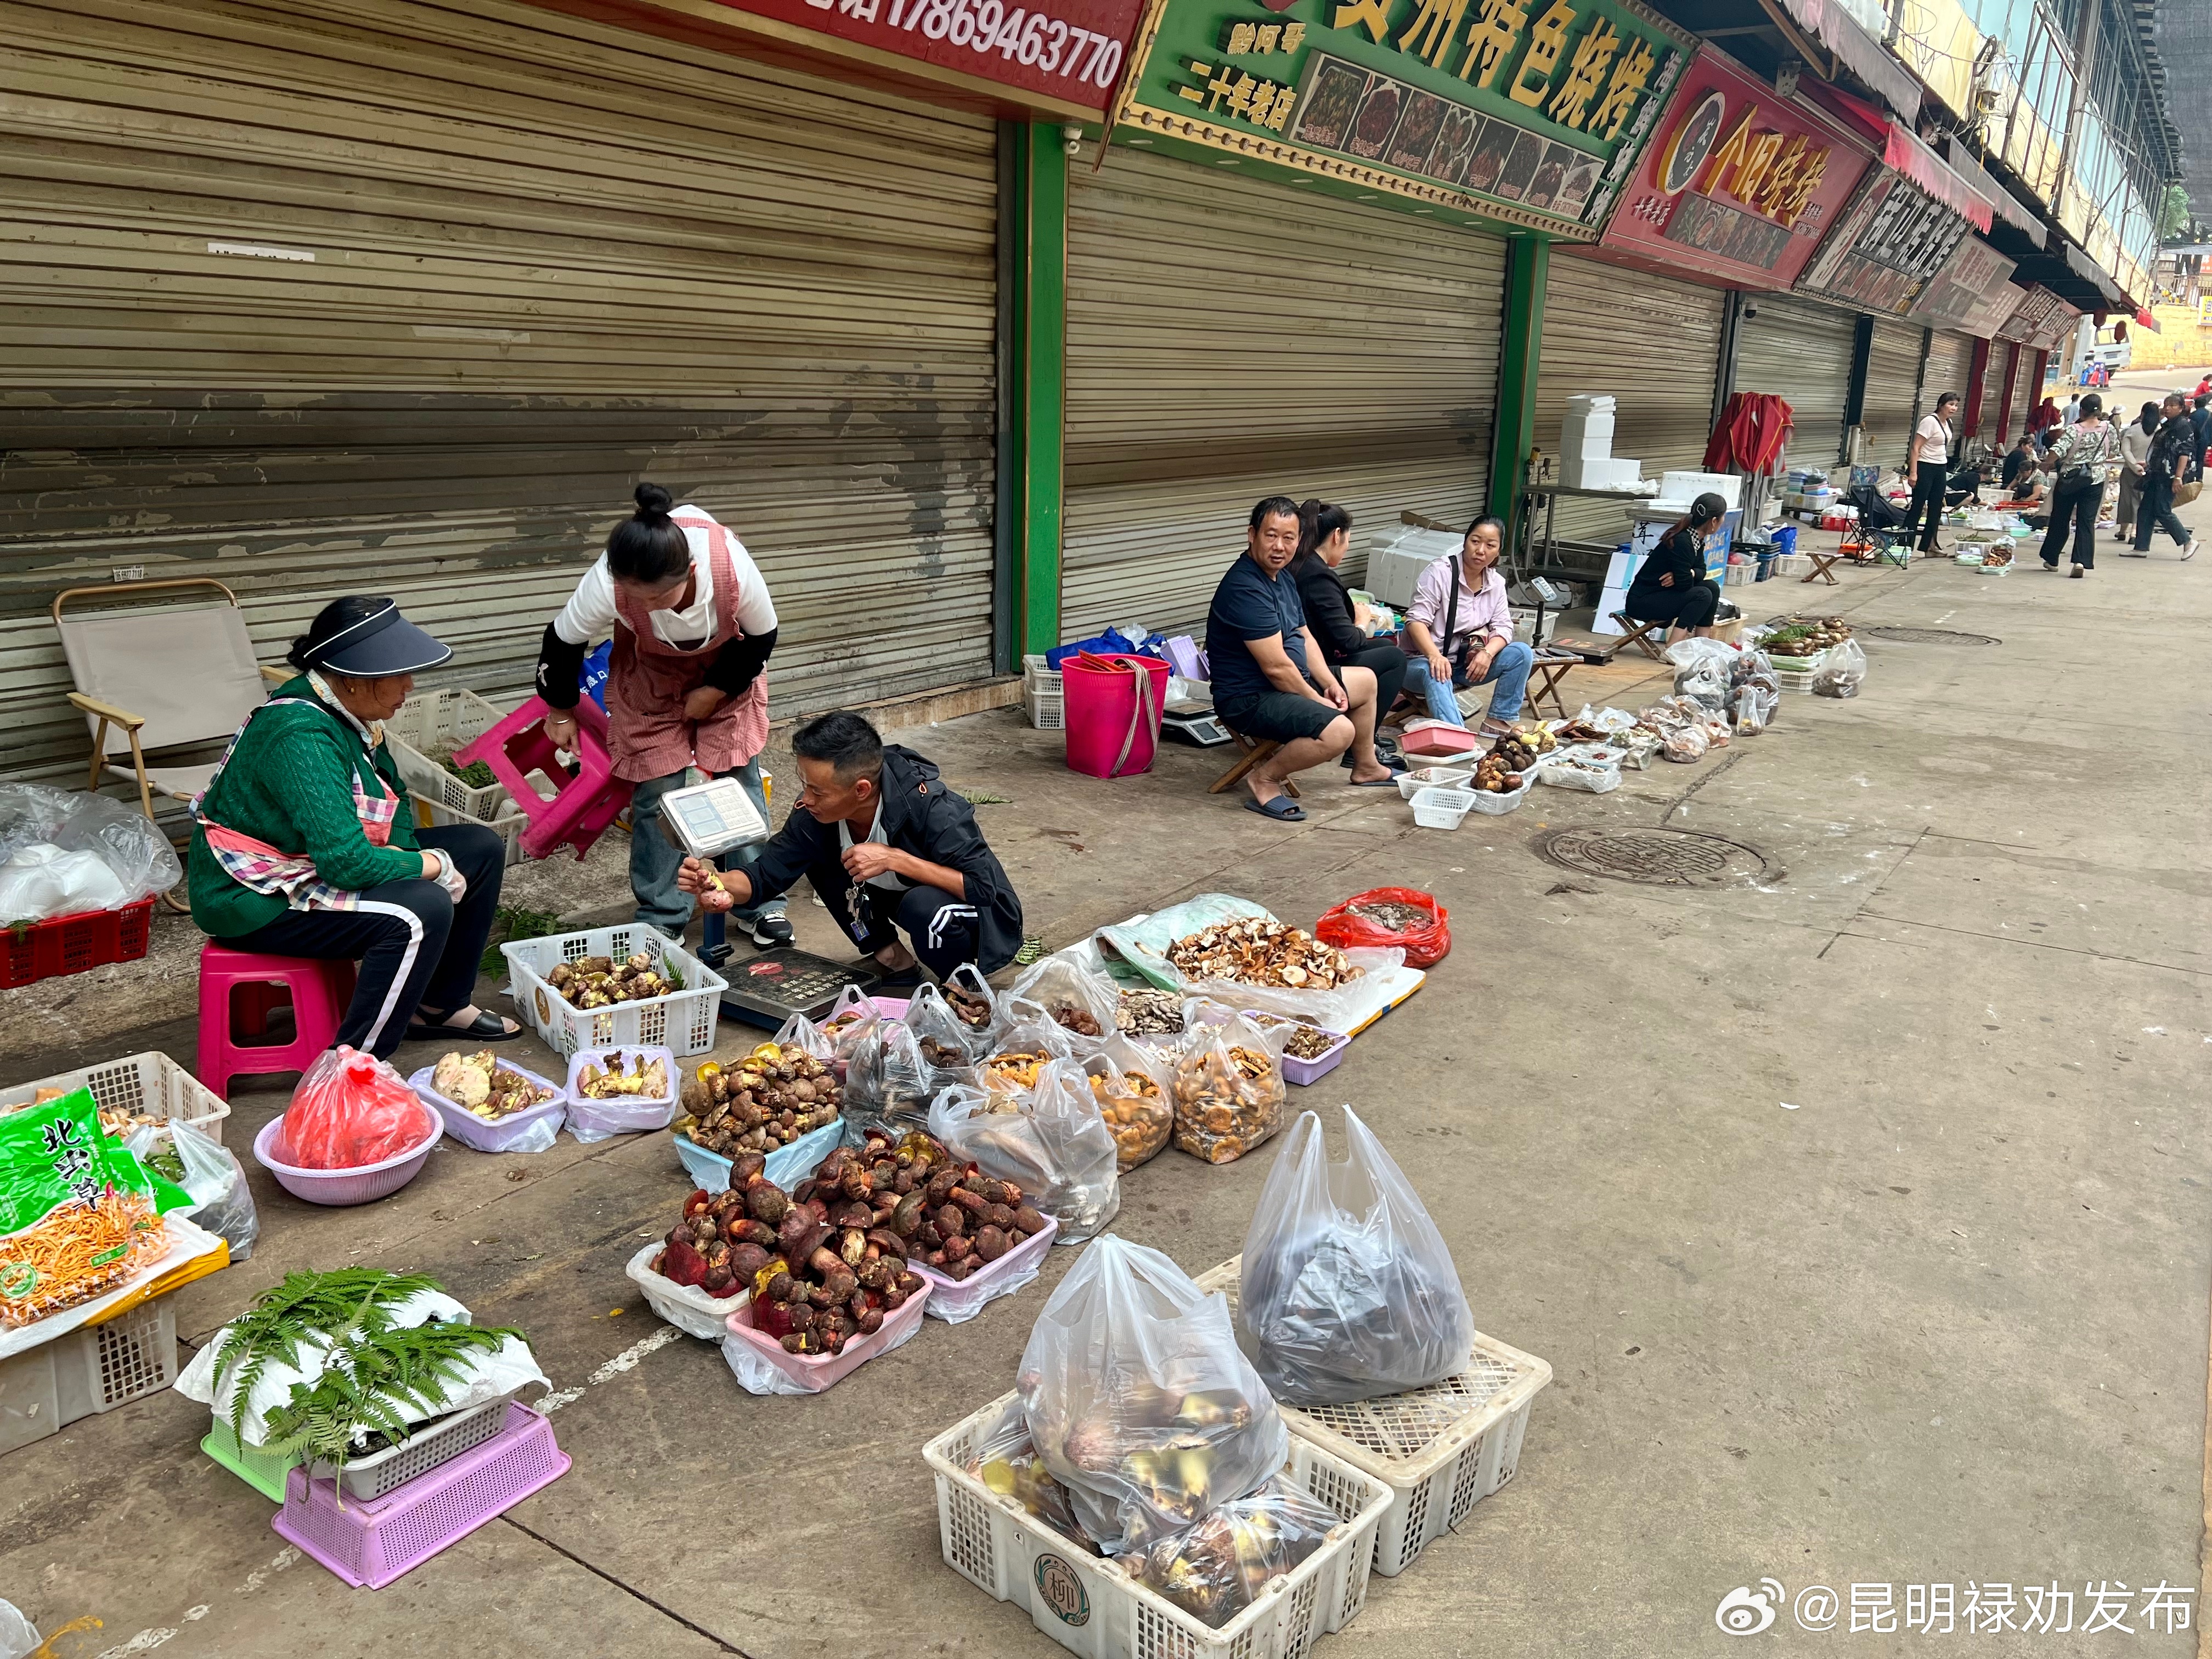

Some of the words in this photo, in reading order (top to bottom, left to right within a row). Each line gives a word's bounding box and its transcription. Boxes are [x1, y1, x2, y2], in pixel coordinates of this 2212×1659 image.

[1227, 22, 1306, 55] 黔阿哥
[1179, 61, 1297, 132] 二十年老店
[1707, 105, 1832, 228] 个旧烧烤
[1633, 198, 1672, 227] 十年老店
[1049, 1572, 1076, 1610] 柳
